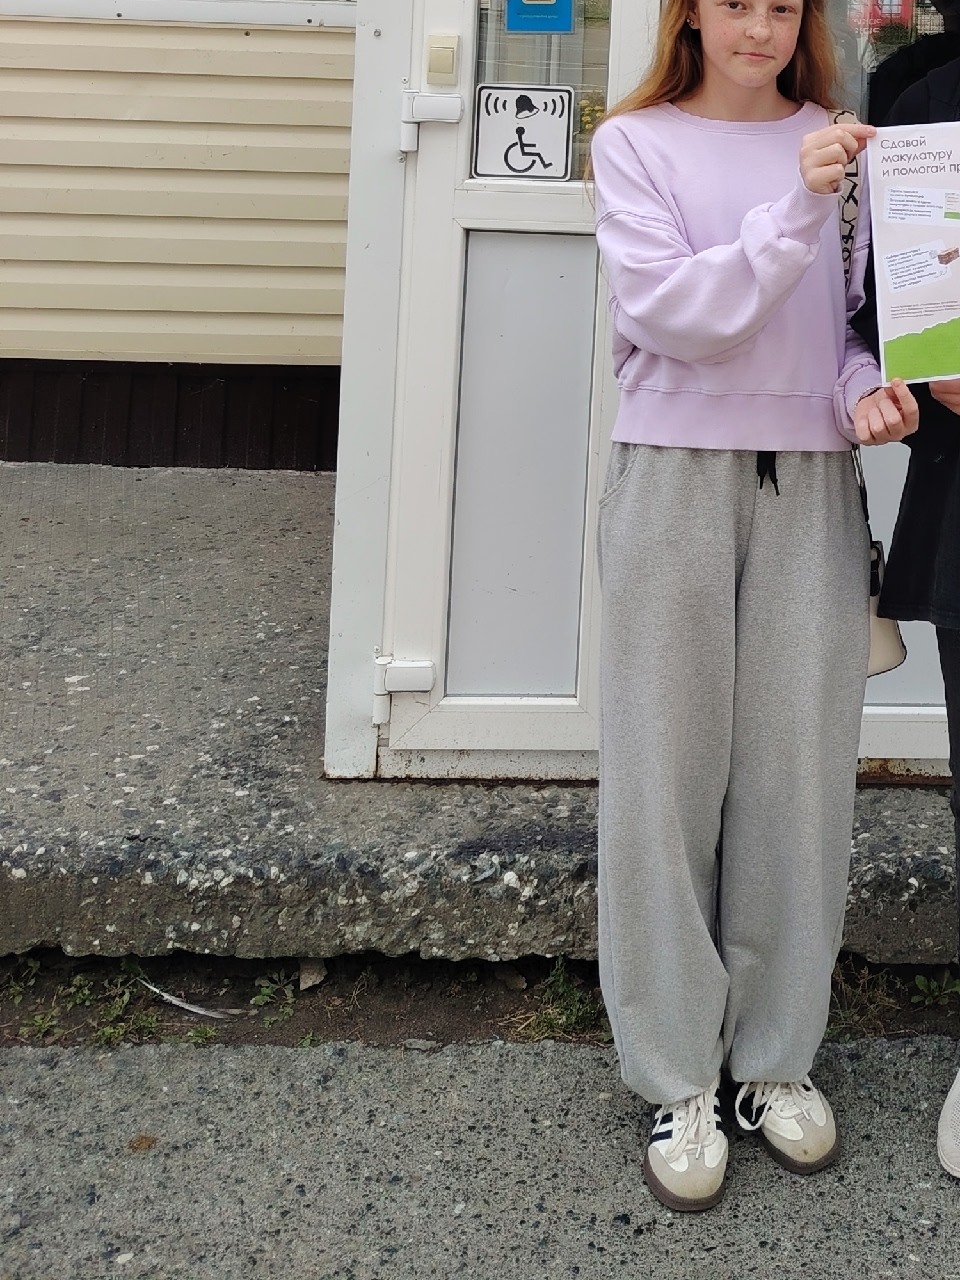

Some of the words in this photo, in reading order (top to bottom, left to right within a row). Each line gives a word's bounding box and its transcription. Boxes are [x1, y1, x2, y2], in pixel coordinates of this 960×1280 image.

[880, 136, 927, 150] Сдавай
[881, 150, 953, 163] макулатуру
[882, 169, 890, 177] и
[892, 162, 946, 176] помогай
